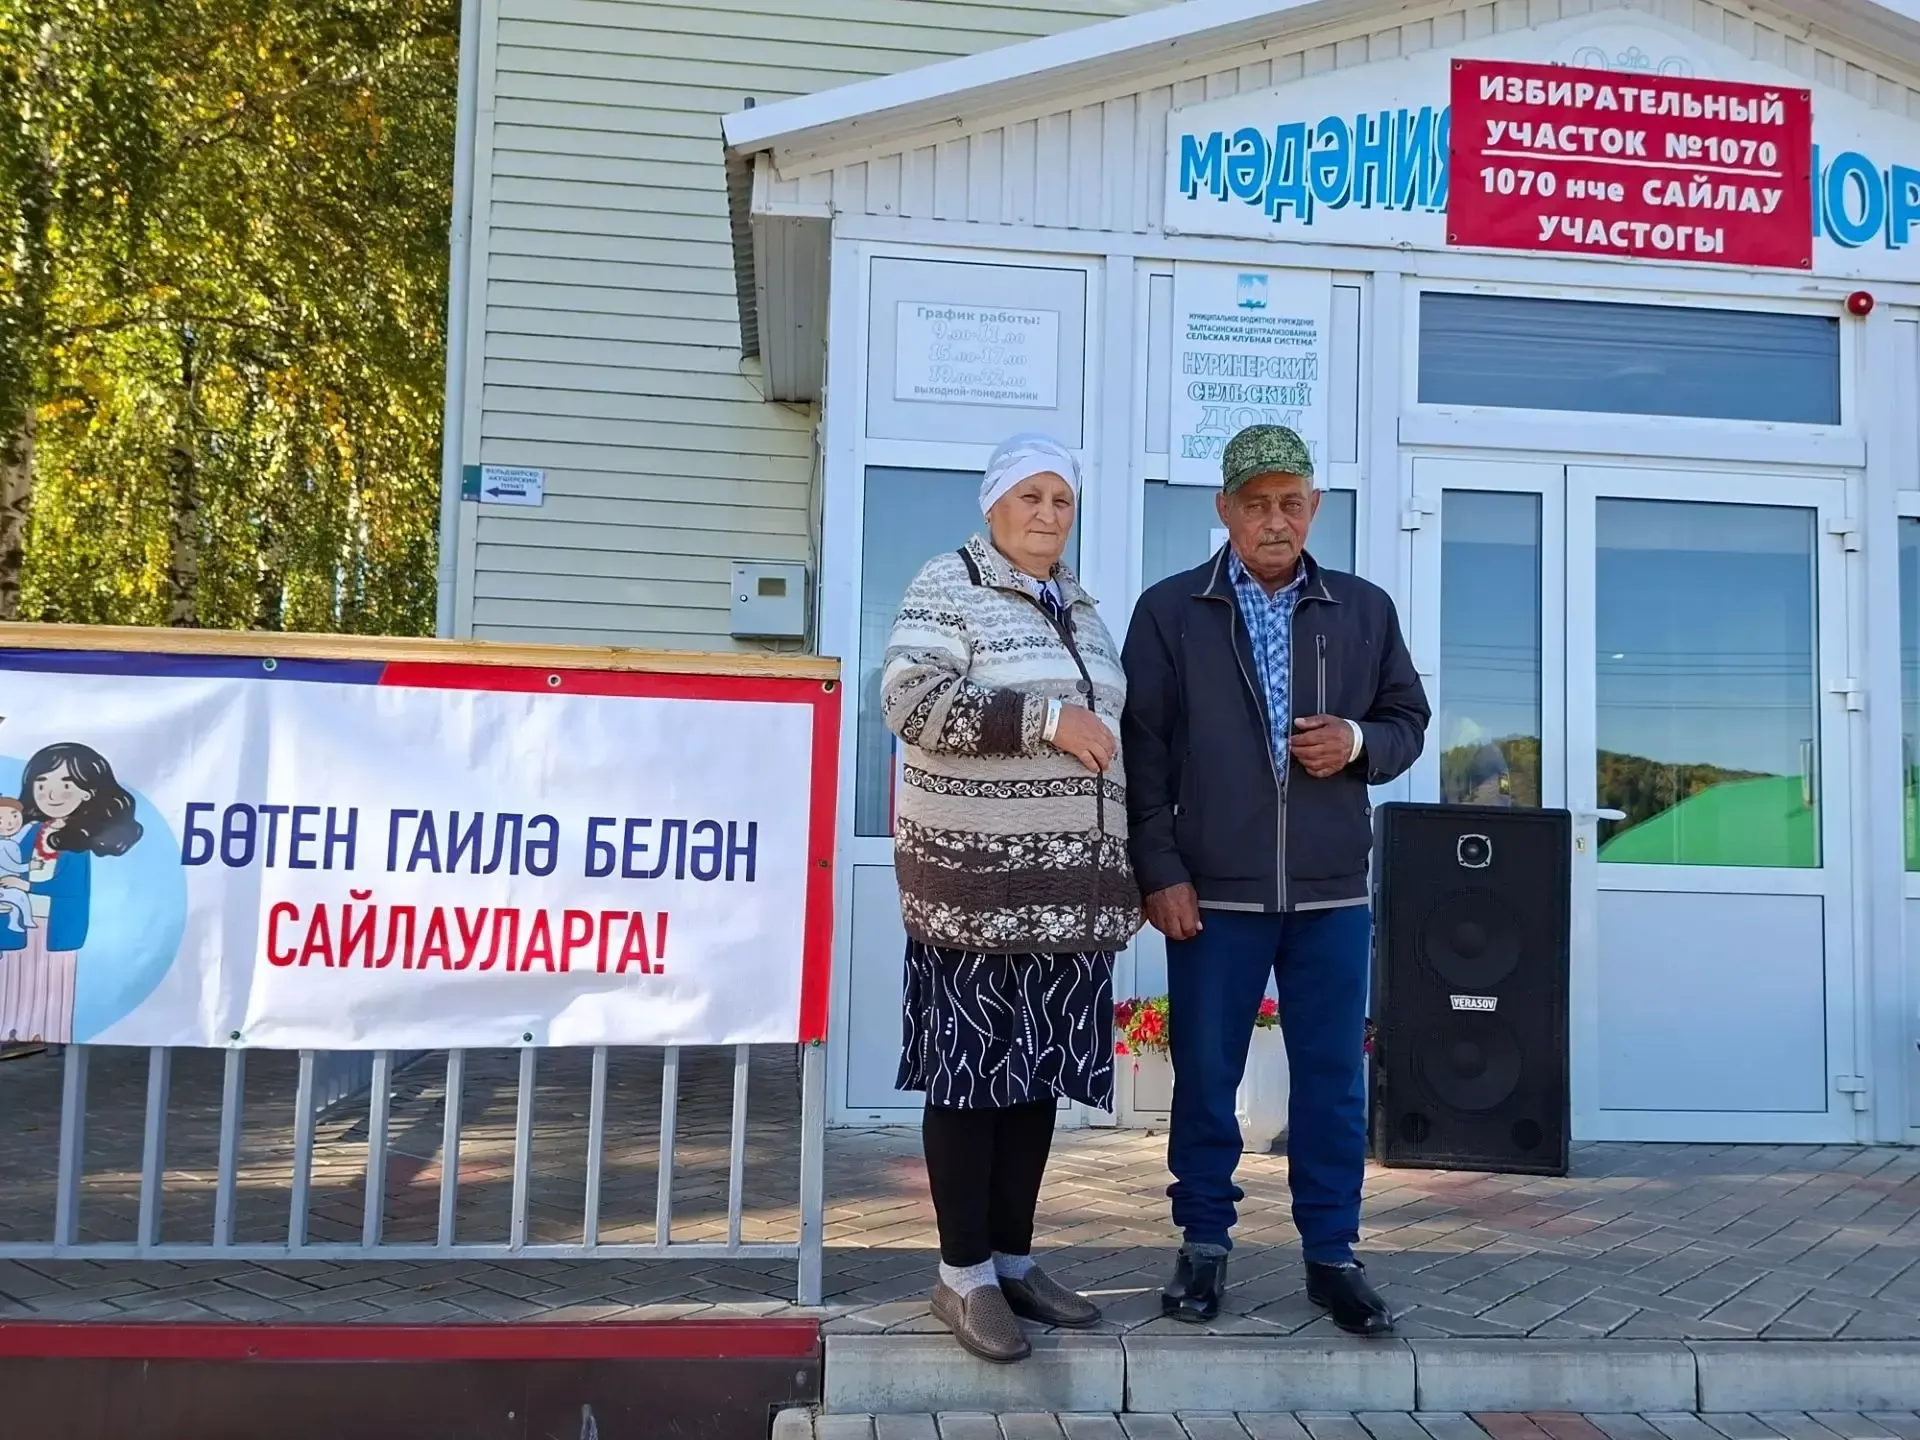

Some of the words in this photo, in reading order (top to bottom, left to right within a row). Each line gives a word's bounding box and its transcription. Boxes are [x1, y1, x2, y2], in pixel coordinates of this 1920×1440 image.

[1480, 75, 1784, 125] ИЗБИРАТЕЛЬНЫЙ
[1487, 119, 1646, 156] УЧАСТОК
[1666, 134, 1777, 166] №1070
[1480, 166, 1556, 197] 1070
[1566, 180, 1625, 202] нче
[1642, 174, 1783, 214] САЙЛАУ
[1811, 143, 1920, 249] ОР
[1538, 215, 1724, 254] УЧАСТОГЫ
[917, 307, 975, 321] График
[980, 312, 1041, 326] работы:
[1189, 313, 1239, 322] МУНИЦИПАЛЬНОЕ
[1240, 316, 1276, 324] БЮДЖЕТНОЕ
[1277, 318, 1314, 326] УЧРЕЖДЕНИЕ
[1244, 327, 1317, 337] ЦЕНТРАЛИЗОВАННАЯ
[1186, 332, 1230, 342] СЕЛЬСКАЯ
[1232, 335, 1272, 344] КЛУБНАЯ
[1183, 352, 1318, 380] НУРИНЕРСКИЙ
[1187, 381, 1312, 406] СЕЛЬСКИЙ
[1196, 405, 1303, 434] ДОМ
[181, 802, 358, 871] БӨТЕН
[387, 809, 560, 877] ГАИЛӘ
[584, 816, 758, 882] БЕЛӘН
[266, 889, 671, 976] САЙЛАУЛАРГА!
